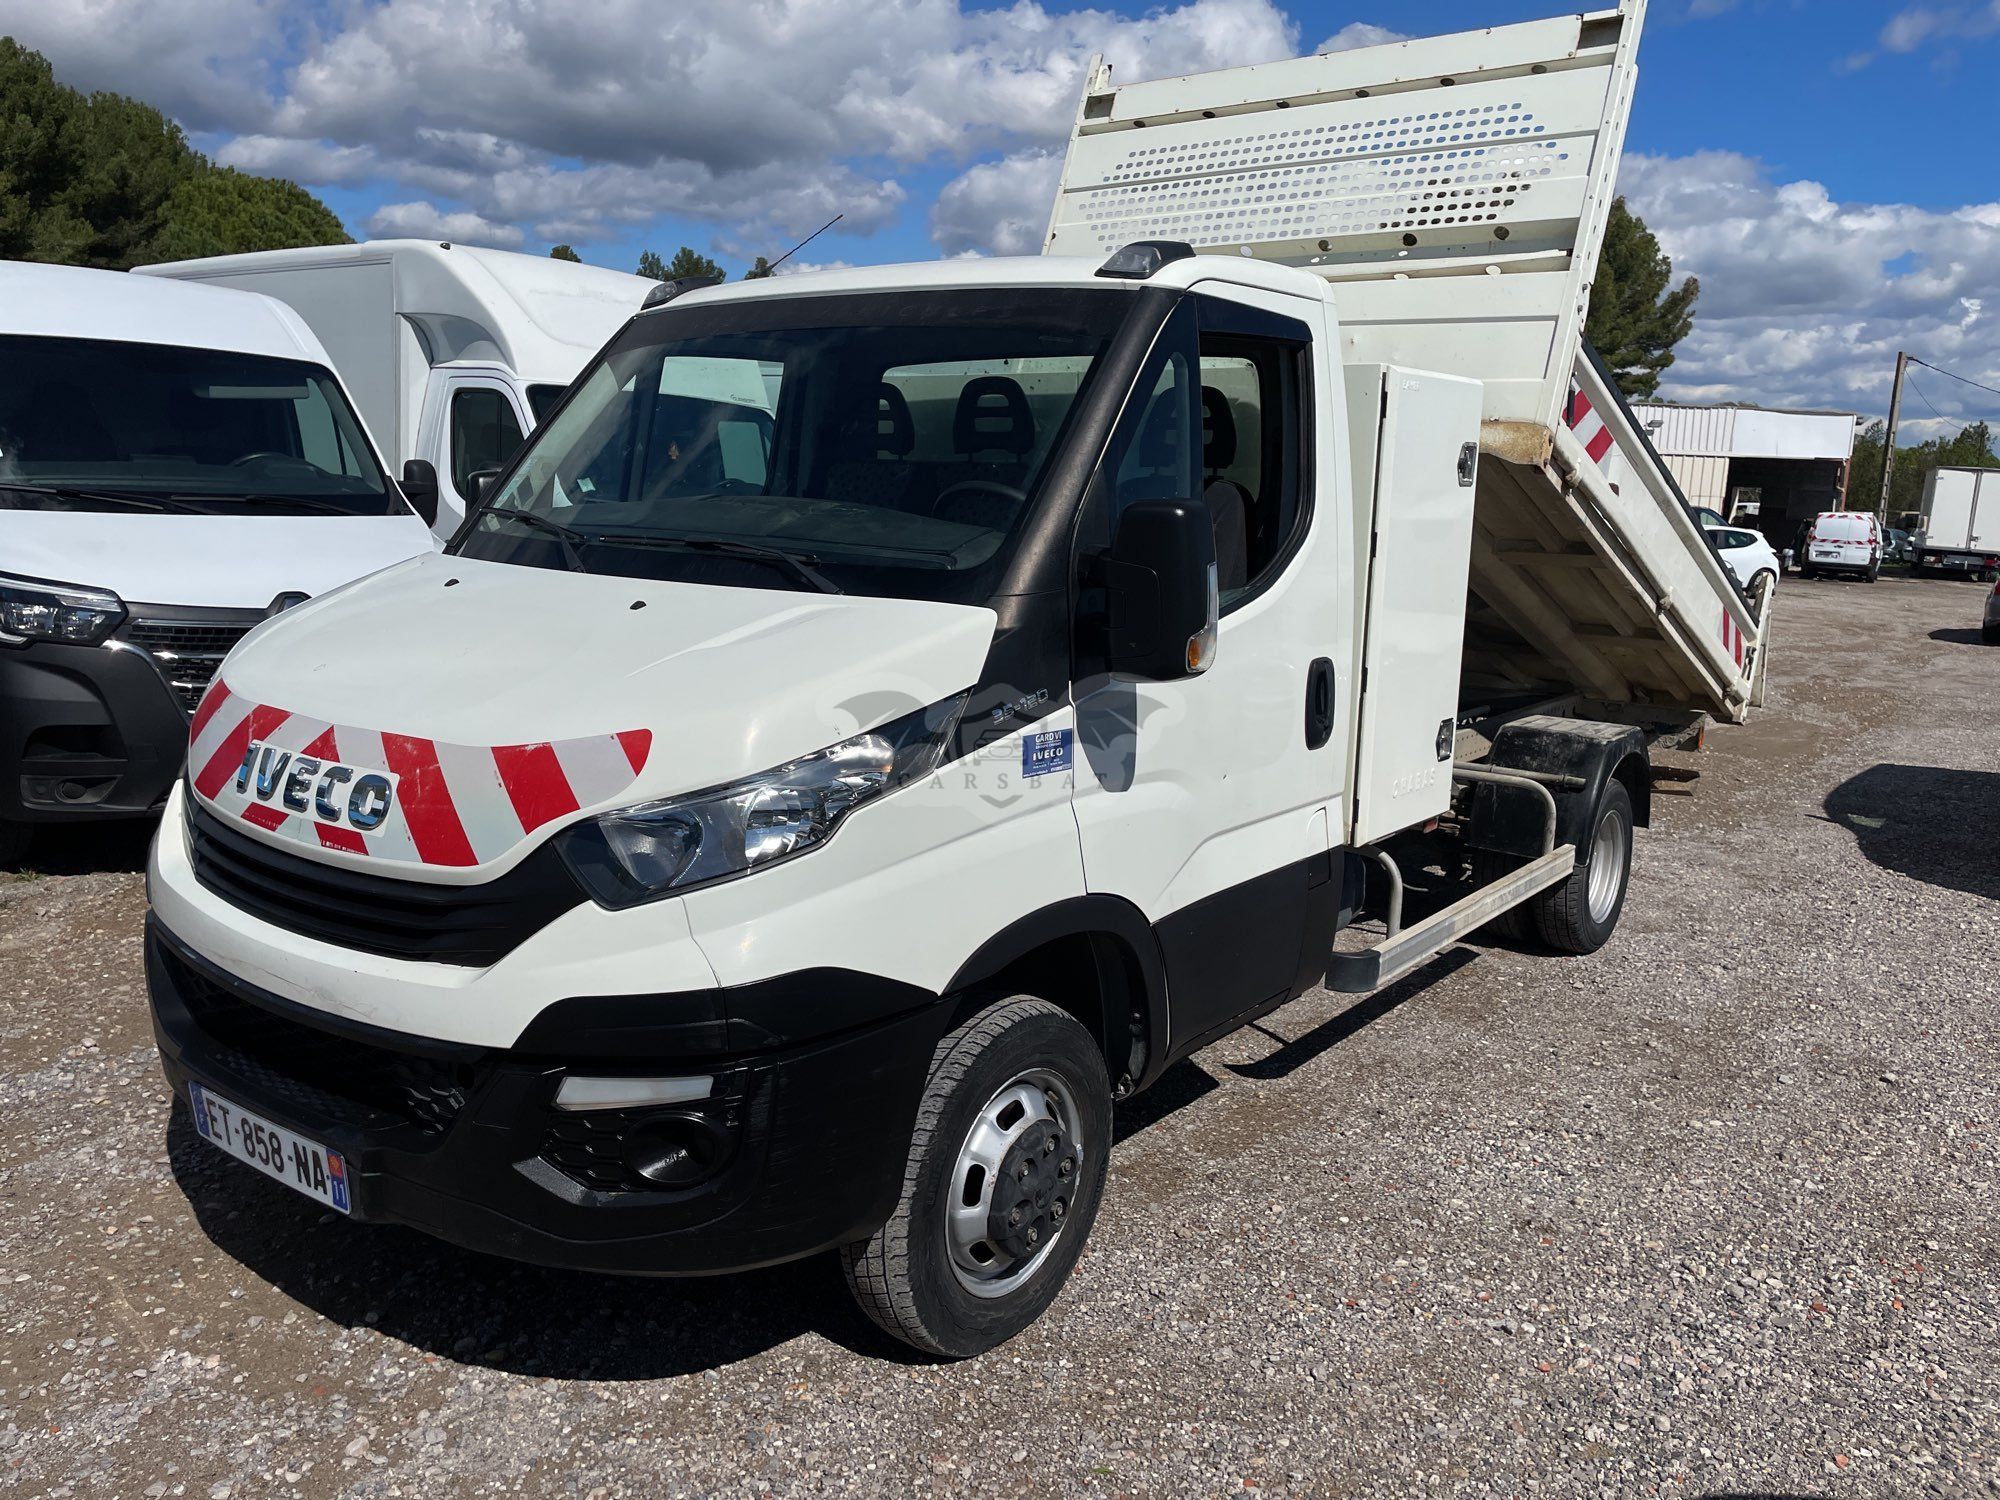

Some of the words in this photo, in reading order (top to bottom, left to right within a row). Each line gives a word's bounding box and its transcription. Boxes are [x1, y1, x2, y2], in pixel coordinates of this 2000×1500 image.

[1032, 747, 1063, 761] IVECO
[236, 742, 393, 831] IVECO
[205, 1097, 328, 1195] ET-858-NA
[332, 1180, 346, 1205] 11
